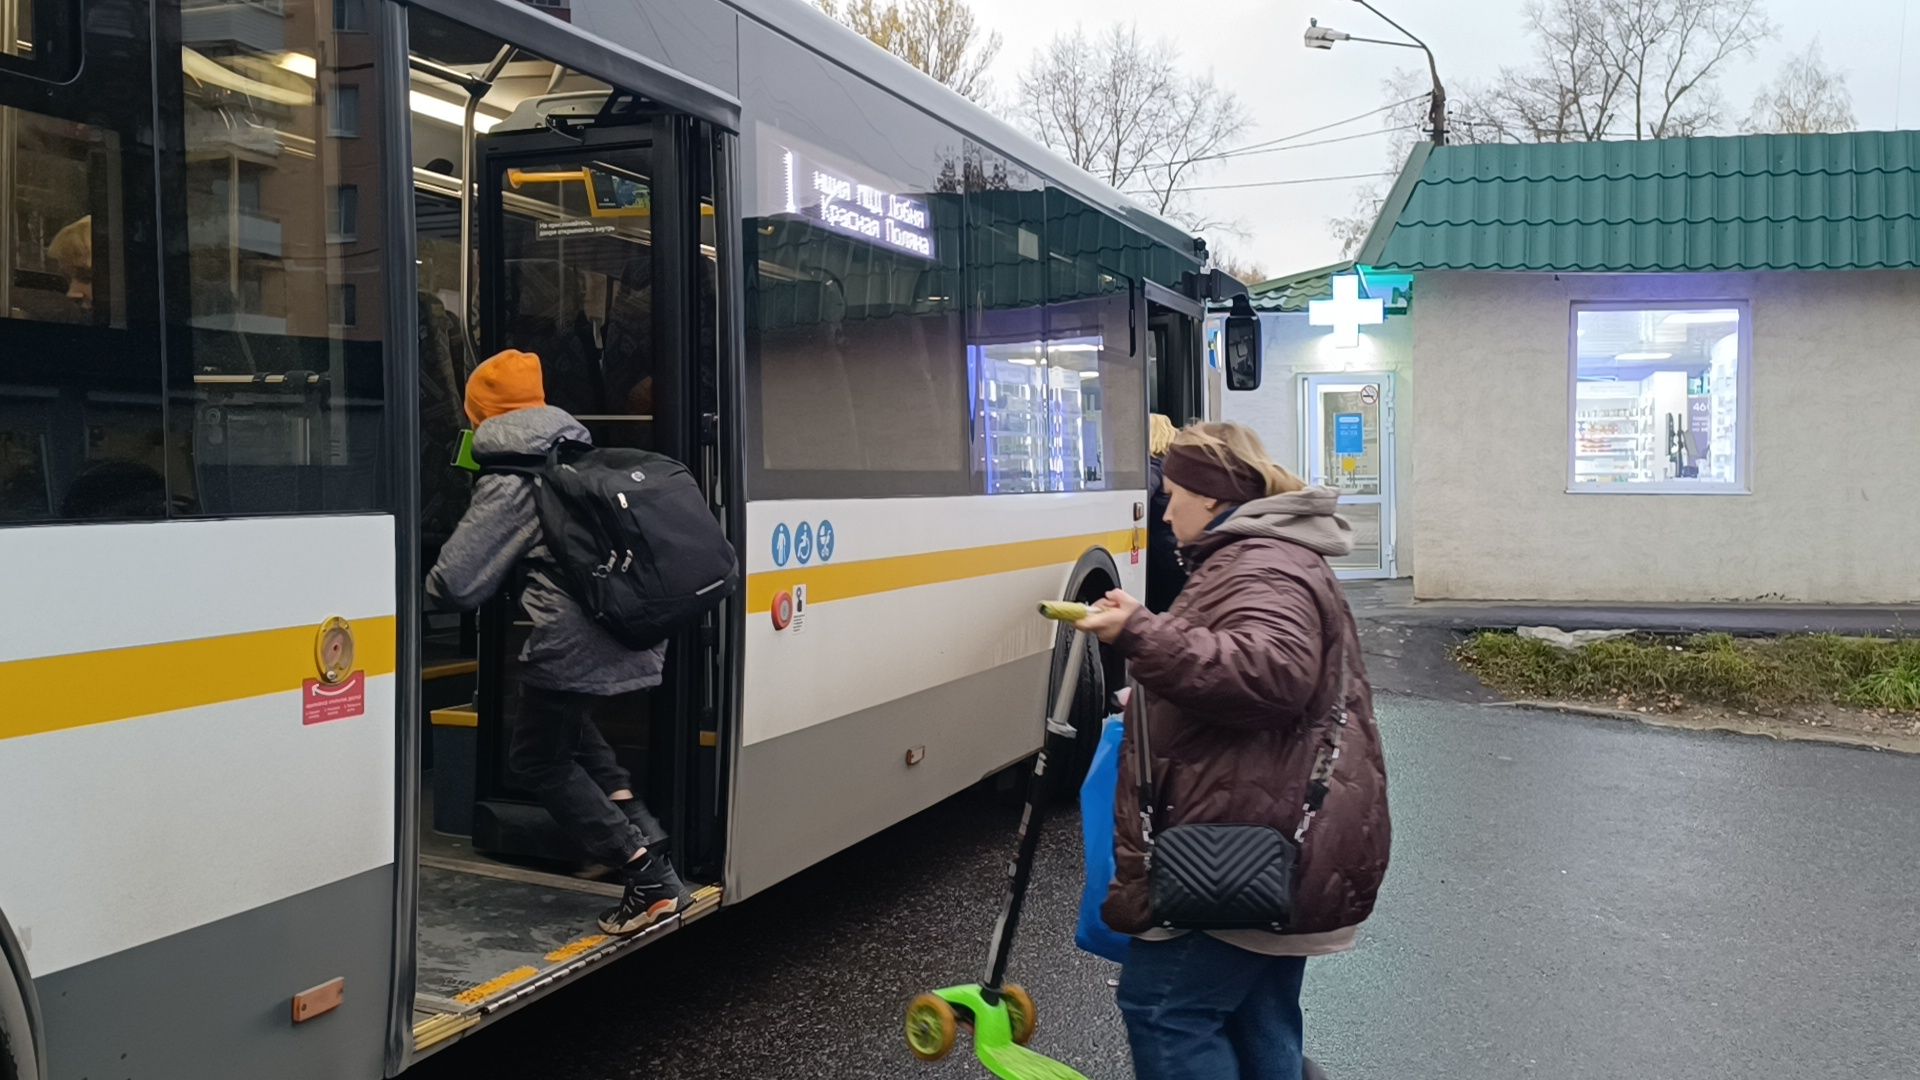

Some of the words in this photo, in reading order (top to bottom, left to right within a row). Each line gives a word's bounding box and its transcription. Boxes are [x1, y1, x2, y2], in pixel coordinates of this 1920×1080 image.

[820, 194, 880, 238] Красная
[885, 217, 930, 255] Поляна
[888, 194, 925, 229] Лобня
